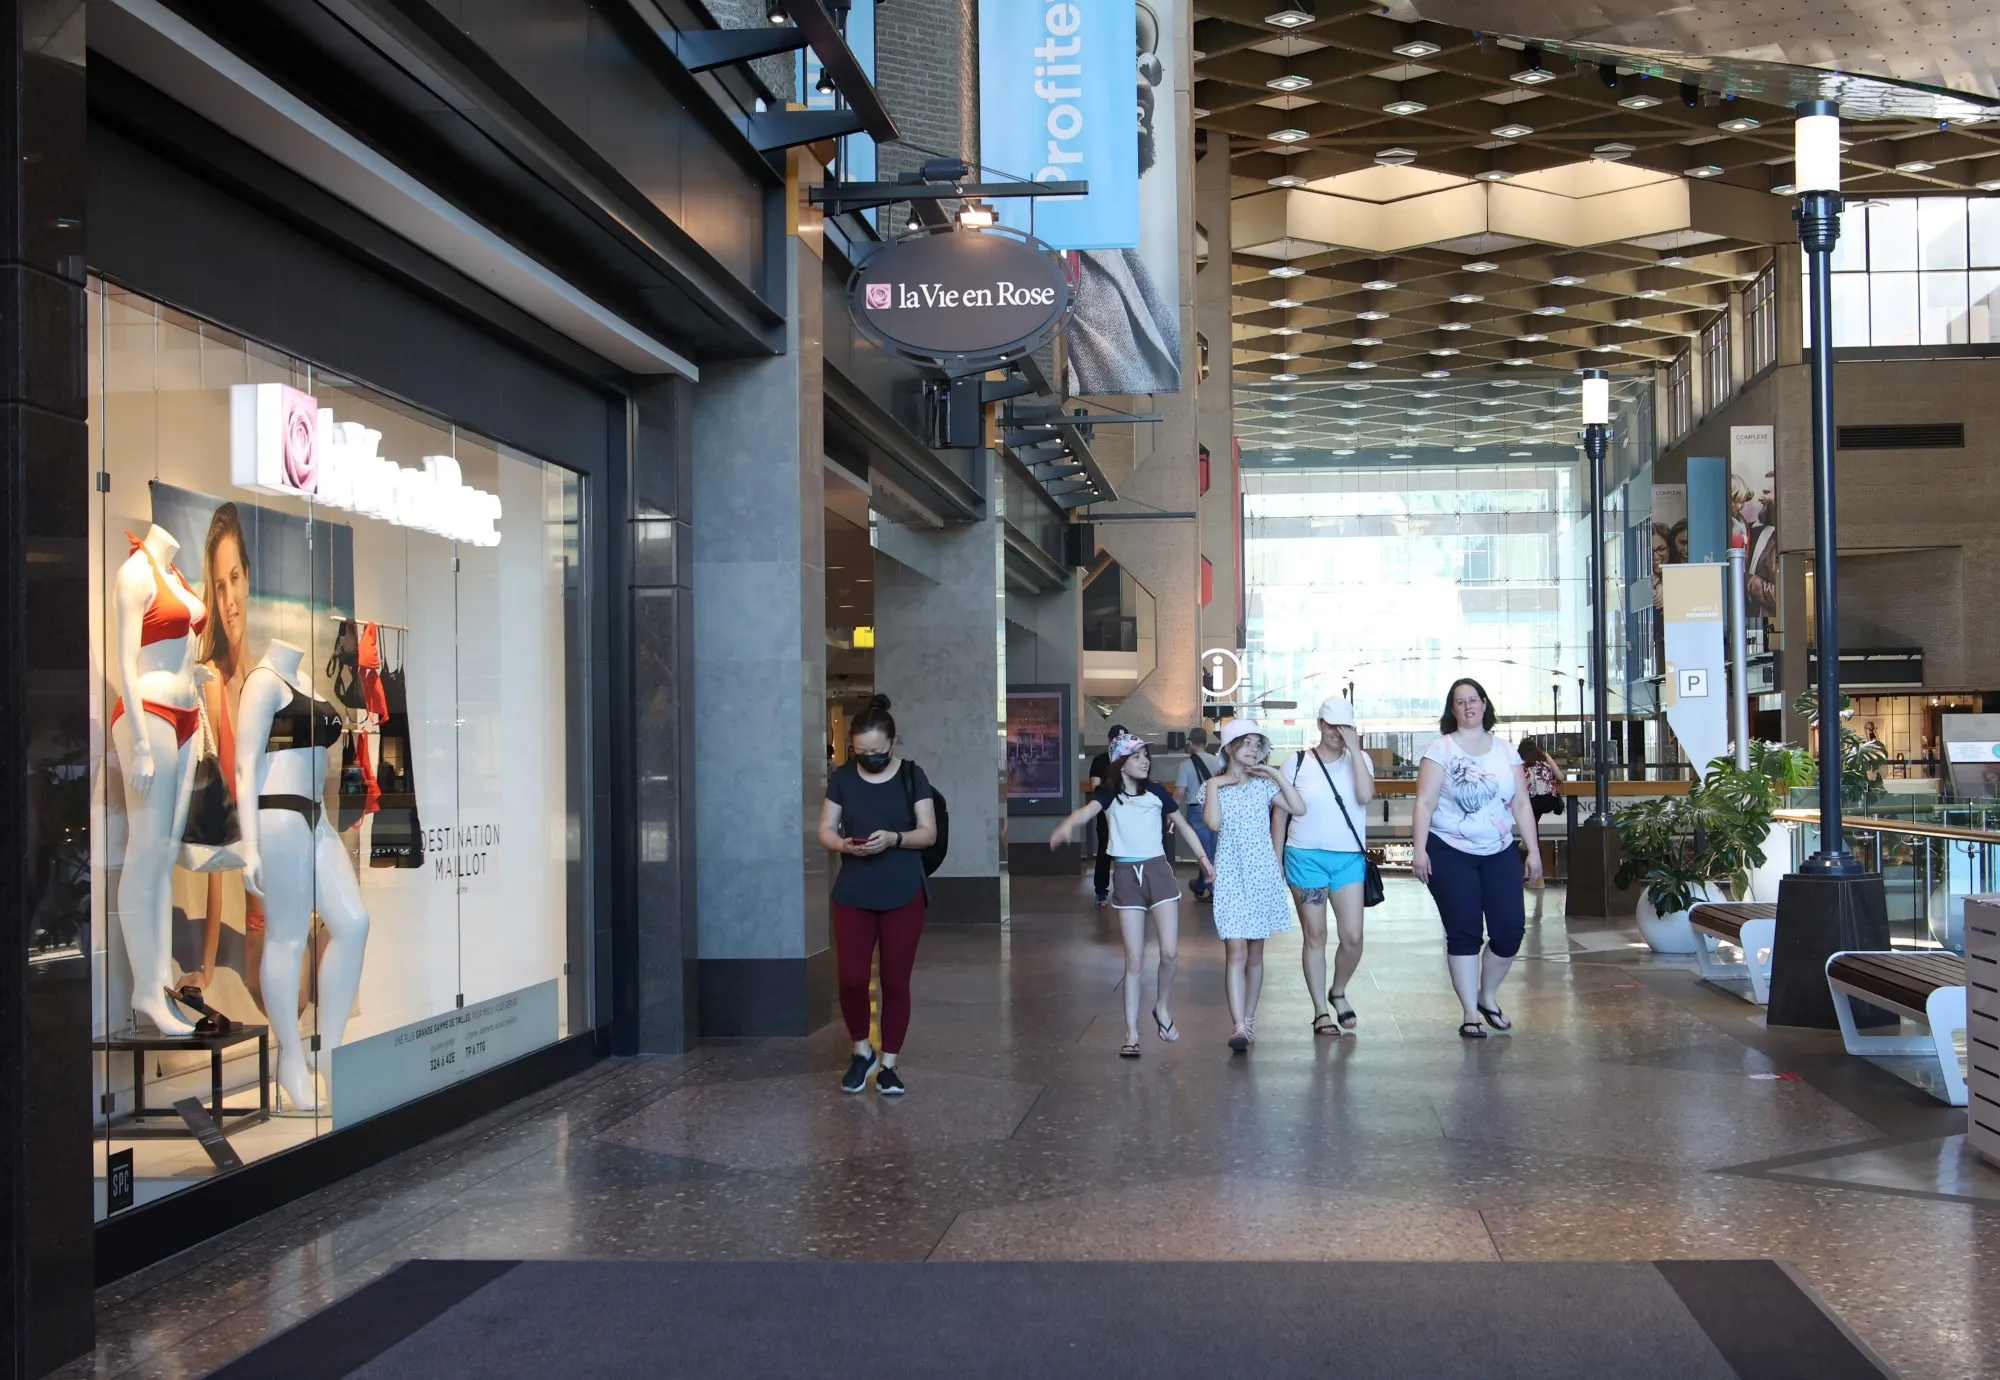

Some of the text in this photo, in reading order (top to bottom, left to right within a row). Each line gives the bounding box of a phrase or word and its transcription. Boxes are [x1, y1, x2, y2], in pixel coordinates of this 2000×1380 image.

[1034, 0, 1083, 200] Profite
[962, 289, 993, 307] en
[996, 281, 1055, 307] Rose
[1735, 433, 1769, 441] COMPLEXE
[1687, 675, 1701, 691] P
[420, 824, 500, 852] DESTINATION
[435, 852, 487, 881] MAILLOT
[415, 1024, 433, 1040] GRANDE
[434, 1022, 449, 1034] GAMME
[449, 1018, 455, 1028] DE
[430, 1058, 441, 1071] 32A
[445, 1052, 455, 1064] 42E
[465, 1046, 473, 1058] TP
[476, 1041, 486, 1052] TTG
[112, 1170, 129, 1197] SPC
